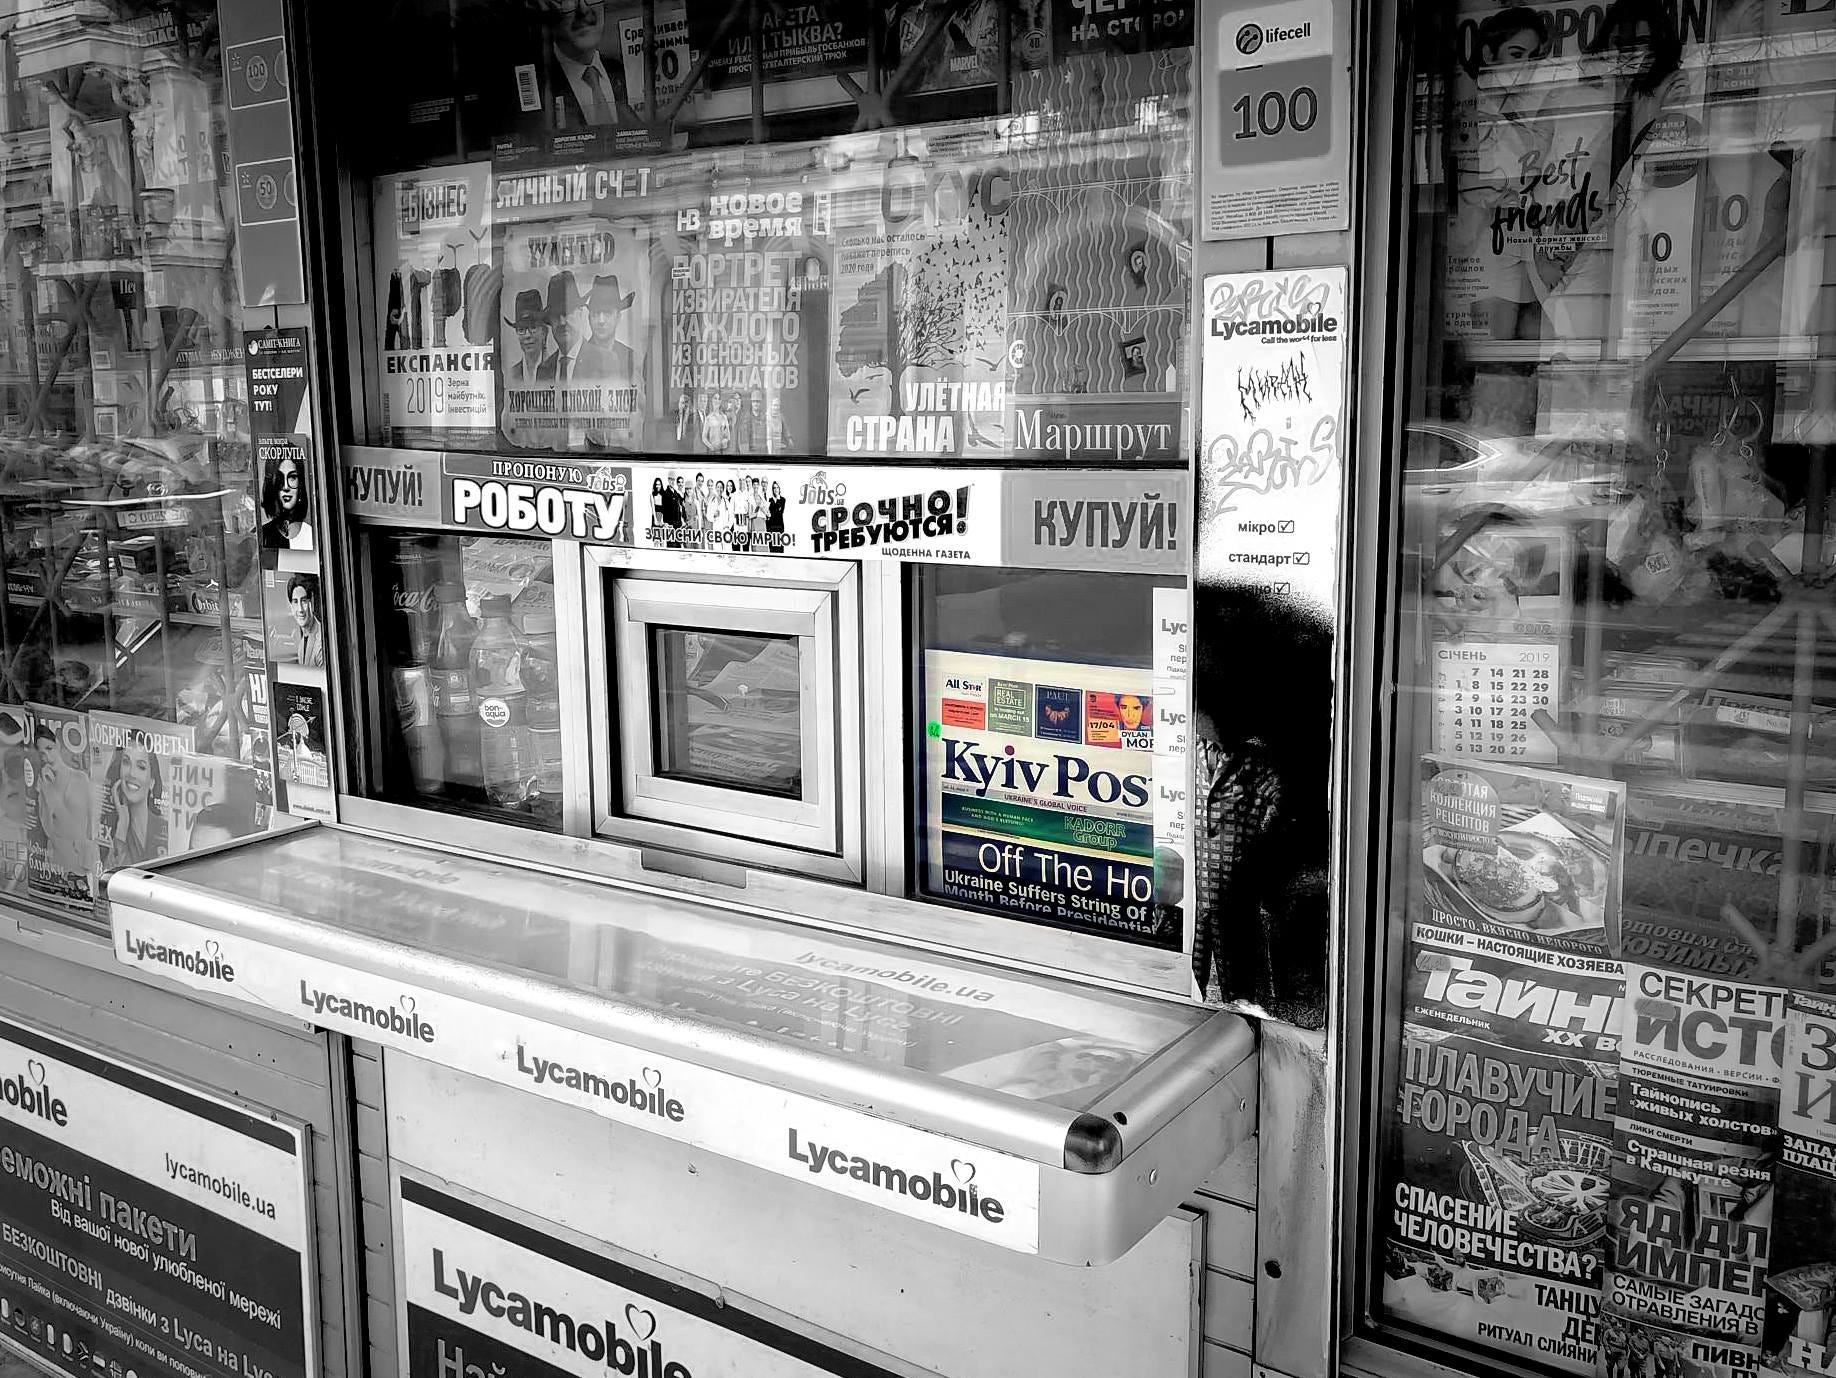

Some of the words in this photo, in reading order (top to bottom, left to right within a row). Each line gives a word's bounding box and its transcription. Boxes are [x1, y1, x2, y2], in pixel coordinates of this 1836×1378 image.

[773, 21, 844, 48] ТЫКВА?
[817, 38, 866, 51] ГОСБАНКОВ
[1265, 22, 1311, 43] lifecell
[248, 64, 265, 79] 100
[950, 55, 979, 72] MARVEL
[1233, 86, 1318, 140] 100
[1518, 136, 1590, 194] Best
[259, 181, 272, 196] 50
[496, 164, 587, 208] ЛИЧНЫЙ
[1490, 171, 1603, 255] friends
[709, 216, 802, 247] время
[887, 232, 926, 243] осталось
[1506, 234, 1533, 244] Новый
[1535, 235, 1567, 246] формат
[528, 232, 616, 268] WANTED
[872, 248, 911, 260] перепись
[1538, 244, 1573, 254] дружбы
[673, 251, 802, 289] ПОРТРЕТ
[857, 263, 874, 273] года
[674, 288, 801, 313] ИЗБИРАТЕЛЯ
[673, 312, 800, 343] КАЖДОГО
[1212, 313, 1337, 340] Lycamobile
[1261, 336, 1276, 344] Call
[1276, 335, 1288, 343] the
[387, 352, 495, 374] ЕКСПАНСІЯ
[673, 343, 692, 365] ИЗ
[696, 343, 799, 366] ОСНОВНЫХ
[252, 366, 303, 380] БЕСТСЕЛЕРИ
[447, 377, 469, 388] Зерна
[671, 365, 799, 390] КАНДИДАТОВ
[253, 384, 279, 396] РОКУ
[406, 377, 444, 414] 2019
[608, 384, 638, 413] ЗЛОЙ
[905, 377, 1006, 412] УЛЁТНАЯ
[254, 400, 273, 412] ТУТ!
[447, 402, 487, 415] інвестицій
[846, 415, 955, 452] СТРАНА
[1014, 408, 1172, 460] Маршрут
[258, 446, 306, 460] СКОРЛУПА
[491, 460, 583, 484] ПРОПОНУЮ
[345, 464, 424, 507] КУПУЙ!
[452, 477, 626, 541] РОБОТУ
[1034, 492, 1177, 551] КУПУЙ!
[645, 526, 703, 543] ЗДІЙСНИ
[706, 530, 749, 545] СВОЮ
[752, 531, 796, 547] МРІЮ!
[811, 514, 953, 553] ТРЕБУЮТСЯ
[1238, 520, 1276, 534] мікро
[881, 547, 932, 558] ЩОДЕННА
[935, 549, 971, 560] ГАЗЕТА
[1228, 552, 1292, 567] стандарт
[1438, 650, 1487, 661] СІЧЕНЬ
[1519, 652, 1551, 663] 2019
[945, 678, 960, 690] All
[1471, 668, 1480, 677] 7
[1490, 668, 1504, 678] 14
[1512, 669, 1526, 678] 21
[1533, 670, 1549, 679] 28
[1471, 681, 1480, 690] 8
[1490, 682, 1504, 691] 15
[1511, 682, 1527, 692] 22
[1533, 683, 1549, 692] 29
[997, 689, 1014, 699] REAL
[997, 696, 1024, 706] ESTATE
[1455, 693, 1463, 702] 2
[1471, 694, 1480, 703] 9
[1490, 694, 1504, 704] 16
[1511, 695, 1527, 705] 23
[1533, 696, 1549, 705] 30
[998, 713, 1021, 722] MARCH
[1455, 706, 1463, 715] 3
[1469, 707, 1482, 715] 10
[1490, 707, 1504, 716] 17
[1511, 708, 1527, 717] 24
[1455, 718, 1463, 728] 4
[1471, 719, 1481, 728] 11
[1490, 720, 1504, 729] 18
[1511, 721, 1527, 730] 25
[1089, 720, 1115, 730] 17/04
[1469, 731, 1482, 741] 12
[1490, 732, 1504, 742] 19
[1511, 733, 1527, 743] 26
[136, 729, 195, 754] СОВЕТЫ
[1455, 744, 1463, 752] 6
[1469, 744, 1482, 753] 13
[1489, 745, 1505, 754] 20
[1511, 746, 1527, 755] 27
[172, 764, 214, 787] ЛИЧ
[941, 737, 1049, 797] Kyiv
[1053, 754, 1152, 808] Pos
[172, 785, 213, 807] НОС
[1004, 794, 1038, 807] UKRAINE'S
[1039, 799, 1066, 811] GLOBAL
[1066, 802, 1087, 813] VOICE
[1430, 792, 1496, 818] КОЛЛЕКЦИЯ
[1064, 816, 1126, 838] KADORR
[1435, 807, 1490, 833] РЕЦЕПТОВ
[1073, 831, 1117, 851] Group
[978, 842, 1024, 878] Off
[1034, 852, 1092, 892] The
[1107, 865, 1152, 902] Ho
[944, 869, 1004, 893] Ukraine
[1008, 881, 1066, 905] Suffers
[1071, 895, 1121, 920] String
[1126, 903, 1147, 921] Of
[1432, 908, 1480, 932] ПРОСТО,
[1535, 933, 1602, 954] НЕДОРОГО
[126, 929, 235, 983] Lycamobile
[1416, 926, 1464, 946] КОШКИ
[1477, 938, 1554, 964] НАСТОЯЩИЕ
[1557, 955, 1624, 975] ХОЗЯЕВА
[796, 951, 995, 1003] lycamobile.ua
[300, 979, 435, 1044] Lycamobile
[1414, 1006, 1491, 1030] ЕЖЕНЕДЕЛЬНИК
[1633, 1050, 1714, 1074] РАССЛЕДОВАНИЯ
[1723, 1069, 1762, 1082] ВЕРСИИ
[516, 1044, 686, 1123] Lycamobile
[1406, 1040, 1619, 1122] ПЛАВУЧИЕ
[1632, 1066, 1685, 1087] ТЮРЕМНЫЕ
[1687, 1079, 1749, 1098] ТАТУИРОВКИ
[1630, 1082, 1721, 1115] Тайнопись
[1402, 1082, 1560, 1159] ГОРОДА
[1629, 1098, 1693, 1124] «живых
[1699, 1114, 1778, 1137] холстов»
[1629, 1121, 1655, 1137] ЛИКИ
[1656, 1128, 1693, 1147] СМЕРТИ
[1627, 1138, 1713, 1173] Страшная
[1718, 1163, 1771, 1182] резня
[1639, 1152, 1734, 1189] Калькутте
[165, 1152, 277, 1221] lycamobile.ua
[788, 1126, 1005, 1224] Lycamobile
[1395, 1182, 1519, 1237] СПАСЕНИЕ
[100, 1190, 197, 1262] пакети
[1394, 1209, 1597, 1280] ЧЕЛОВЕЧЕСТВА?
[51, 1198, 71, 1226] Від
[74, 1214, 112, 1242] вашої
[114, 1233, 150, 1263] нової
[152, 1250, 226, 1301] улюбленої
[228, 1289, 282, 1330] мережі
[2, 1222, 103, 1291] БЕЗКОШТОВНІ
[106, 1287, 158, 1327] дзвінки
[174, 1317, 213, 1358] Lyca
[217, 1345, 238, 1372] на
[1613, 1274, 1686, 1306] САМЫЕ
[1611, 1290, 1740, 1333] ОТРАВЛЕНИЯ
[1745, 1320, 1759, 1336] В
[1478, 1321, 1533, 1347] РИТУАЛ
[1537, 1336, 1598, 1365] СЛИЯНИ
